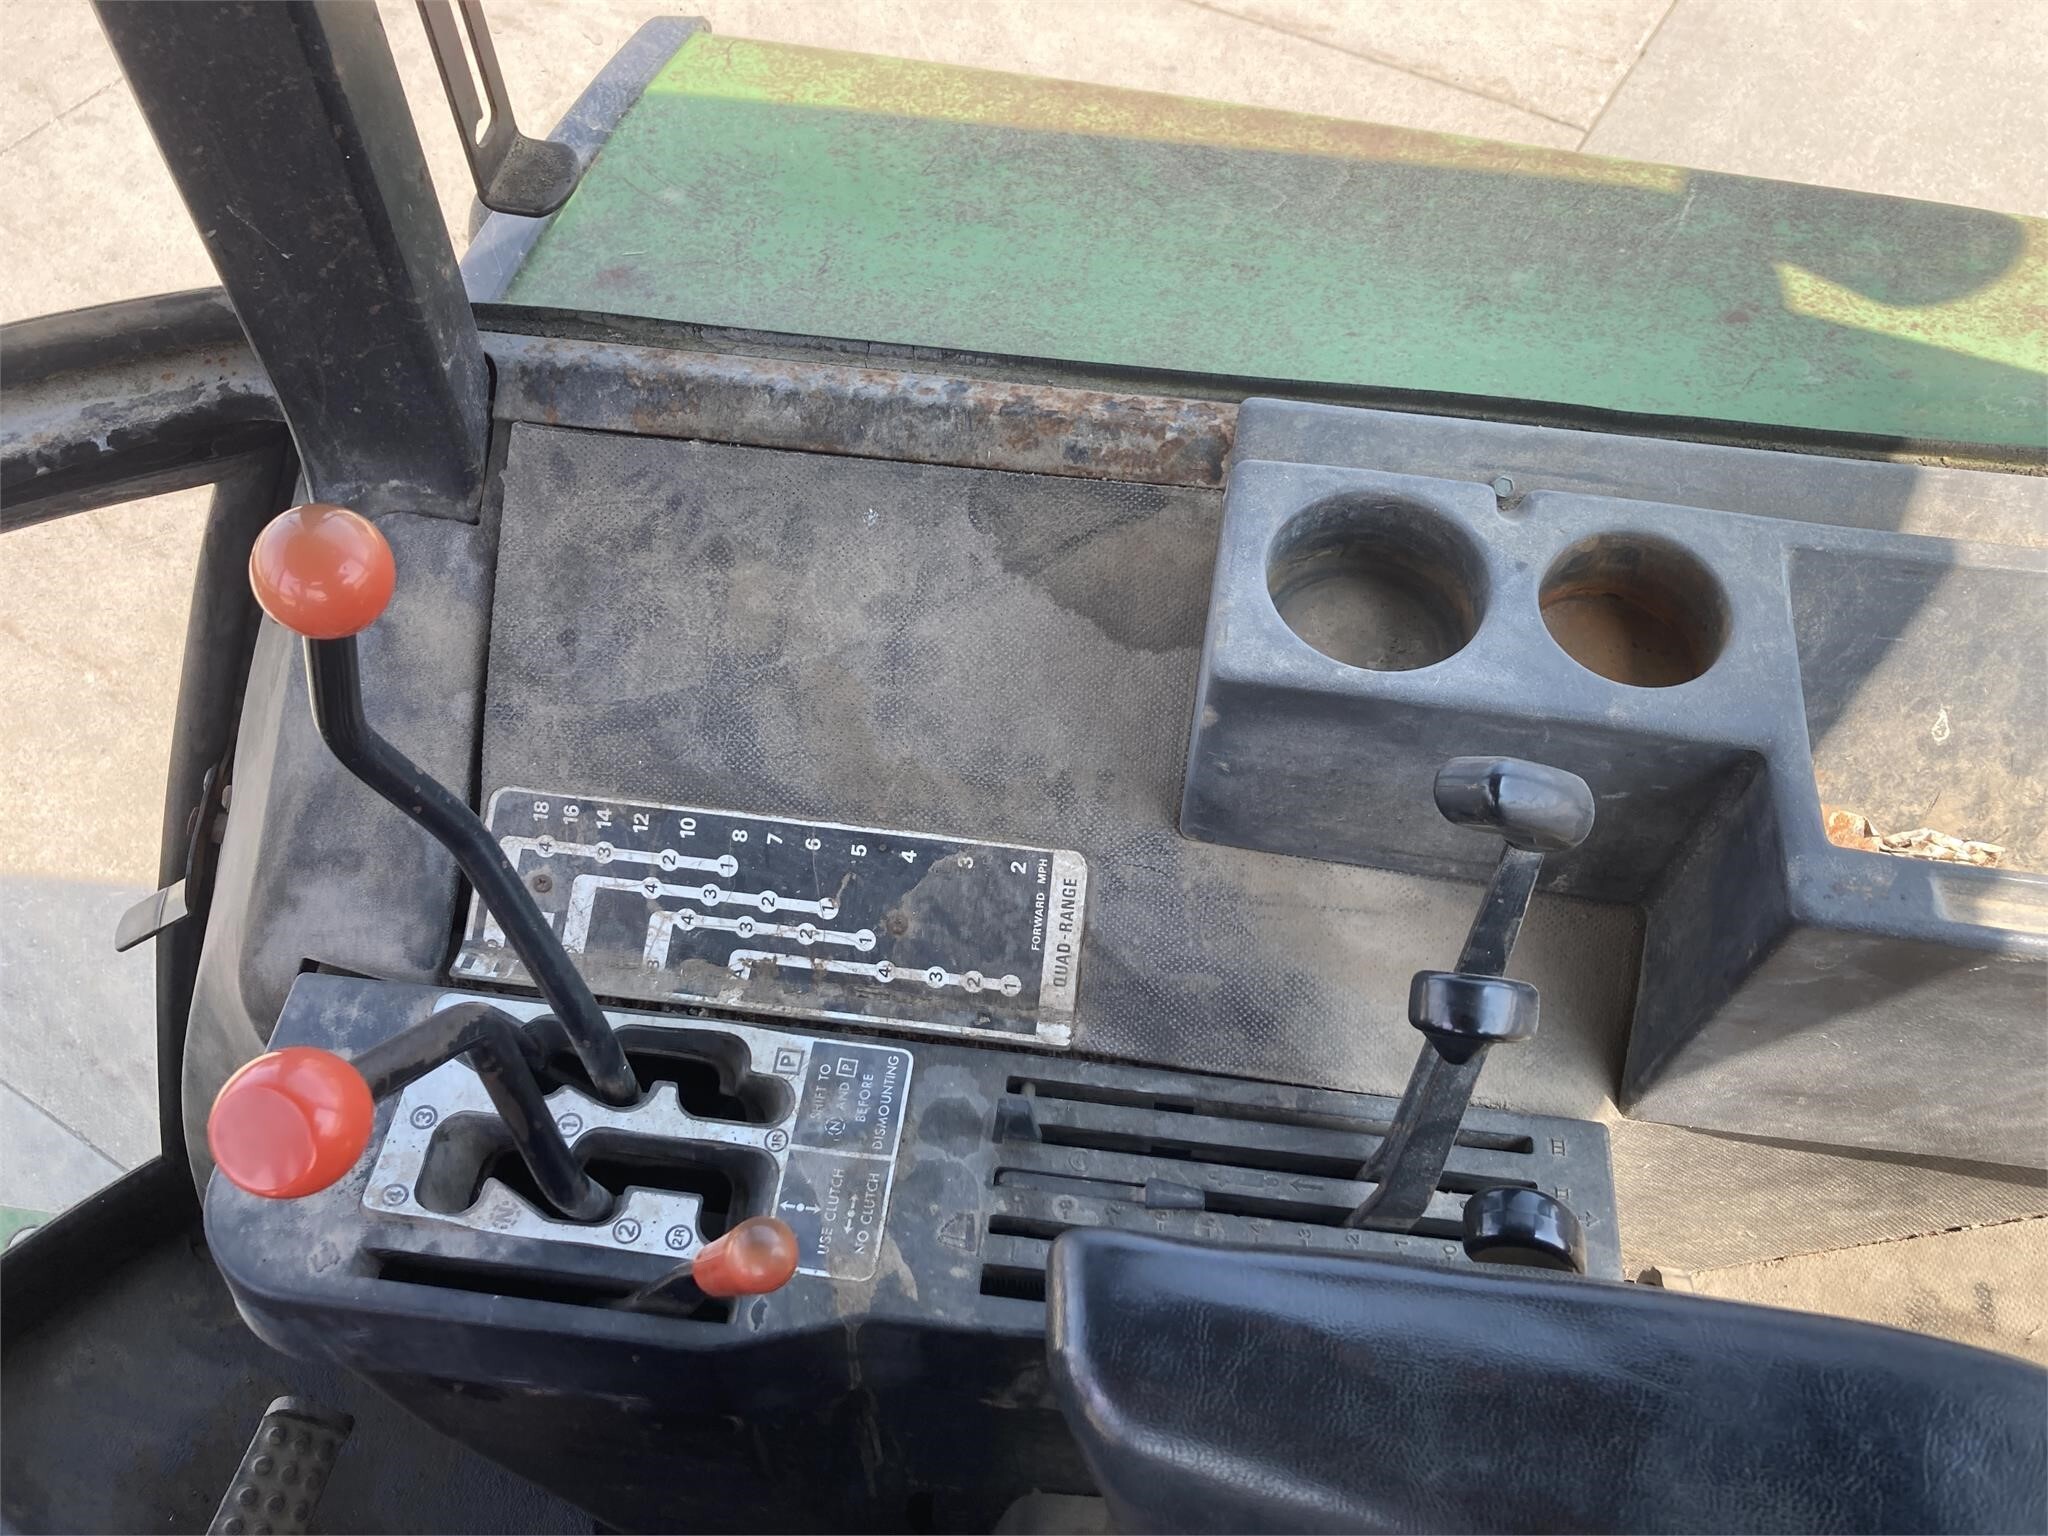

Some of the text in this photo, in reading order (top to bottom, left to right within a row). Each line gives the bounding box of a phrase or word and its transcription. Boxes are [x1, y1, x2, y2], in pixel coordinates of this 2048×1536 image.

[533, 801, 550, 821] 18
[563, 805, 580, 825] 16
[596, 808, 612, 829] 14
[633, 813, 649, 833] 12
[680, 817, 696, 839] 10
[731, 829, 748, 843] 8
[766, 832, 783, 845] 7
[805, 838, 822, 851] 6
[539, 842, 552, 852] 4
[599, 847, 611, 858] 3
[663, 854, 676, 865] 2
[850, 844, 867, 857] 5
[901, 849, 918, 863] 4
[957, 856, 974, 869] 3
[1010, 861, 1027, 874] 2
[645, 884, 658, 894] 4
[703, 889, 717, 899] 3
[761, 896, 776, 907] 2
[1031, 858, 1048, 951] FORWARD MPH
[681, 914, 694, 925] 4
[739, 922, 753, 933] 3
[800, 929, 813, 939] 2
[1053, 878, 1078, 988] QUAD-RANGE
[878, 965, 890, 978] 4
[929, 972, 942, 982] 3
[967, 977, 980, 987] 2
[810, 1064, 831, 1118] SHIFT TO
[836, 1082, 850, 1110] AND
[855, 1074, 874, 1122] BEFORE
[872, 1055, 899, 1150] DISMOUNTING
[817, 1168, 846, 1255] USE CLUTCH
[854, 1172, 880, 1255] NO CLUTCH
